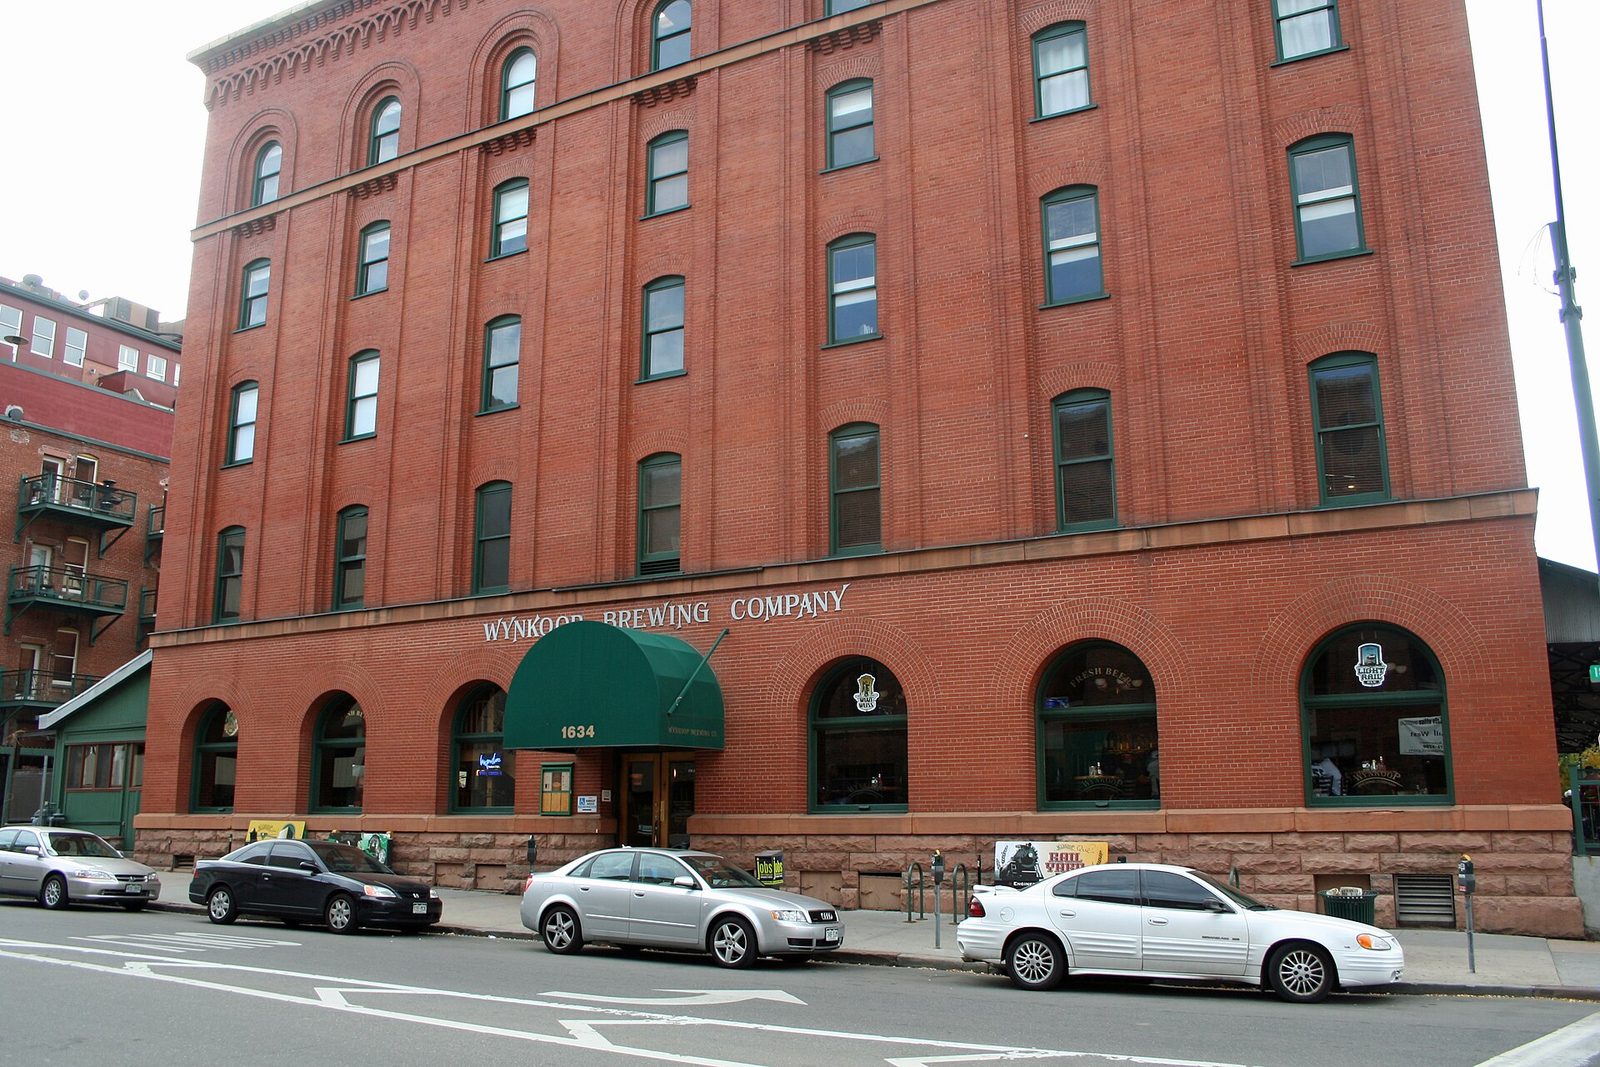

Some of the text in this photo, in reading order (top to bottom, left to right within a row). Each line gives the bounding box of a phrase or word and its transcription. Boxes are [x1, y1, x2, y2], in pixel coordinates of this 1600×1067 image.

[603, 601, 709, 630] BREWING
[730, 583, 850, 622] COMPANY
[1070, 667, 1133, 688] FRESH BEER
[561, 725, 595, 738] 1634
[1049, 852, 1082, 863] RAIL
